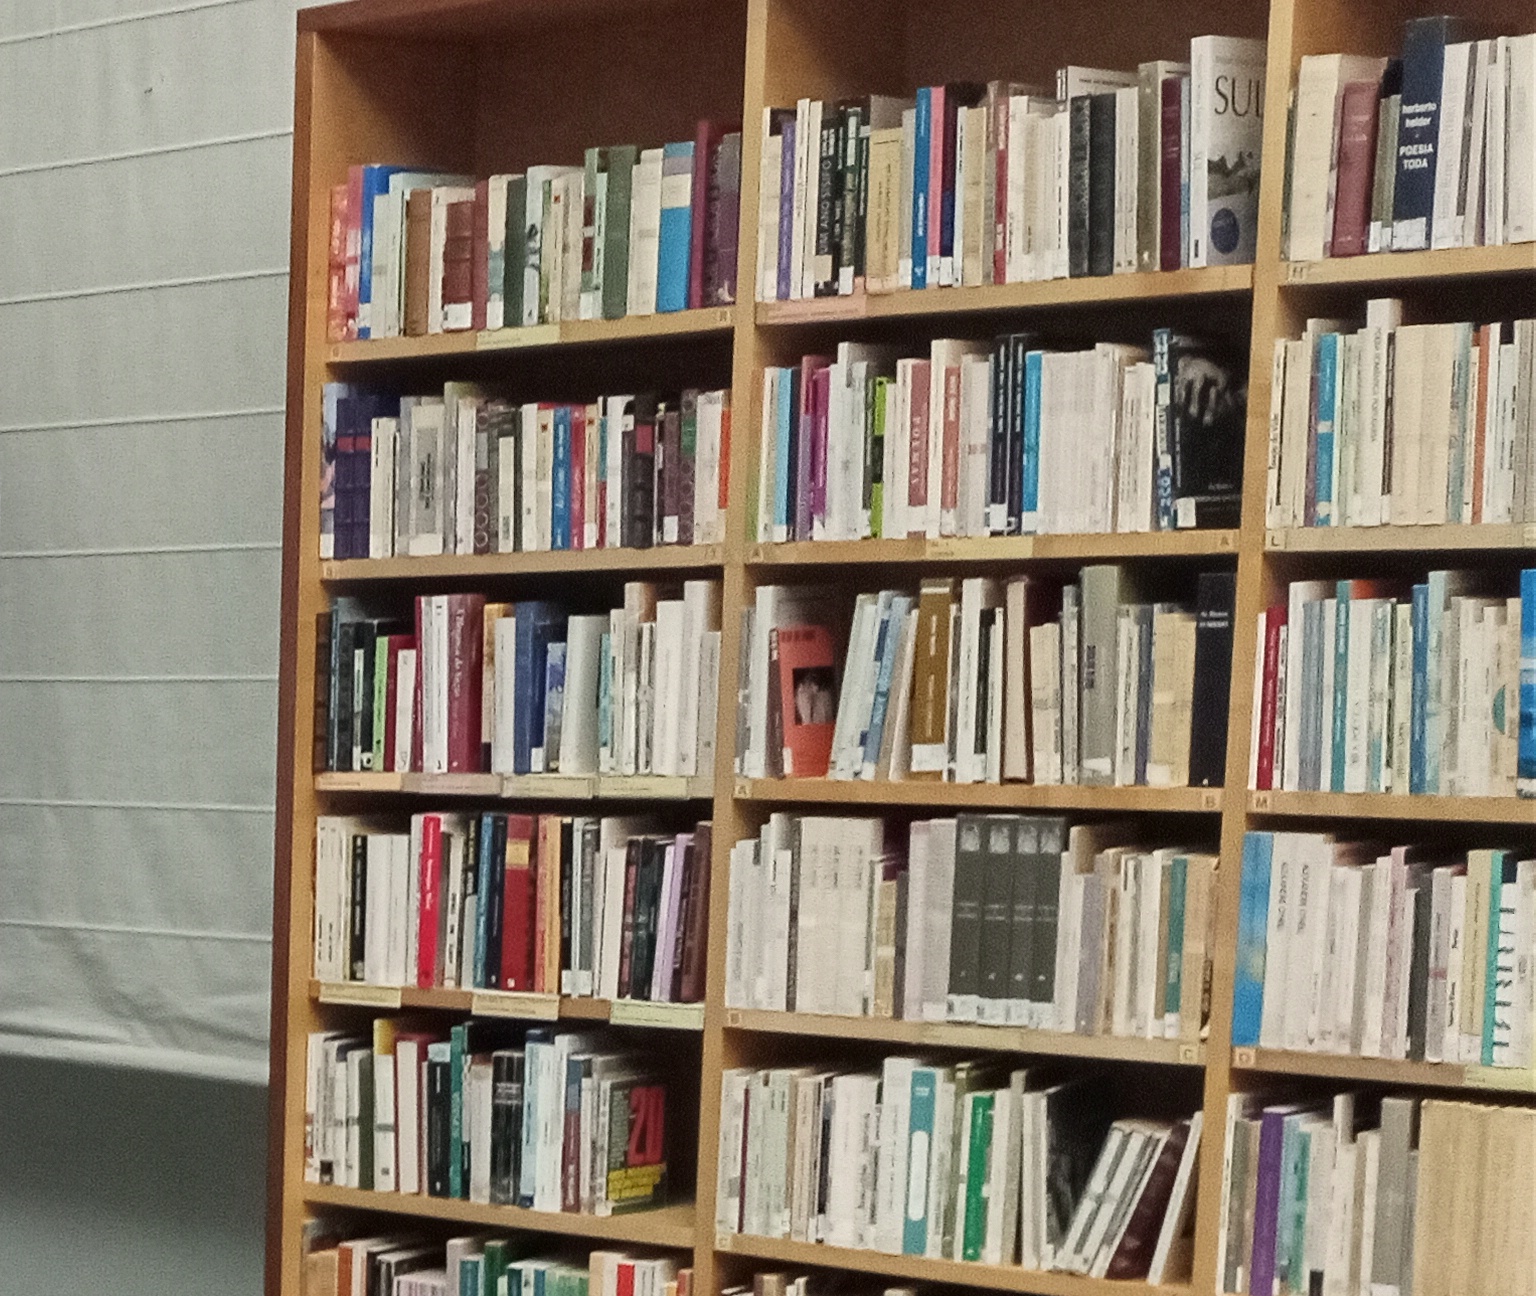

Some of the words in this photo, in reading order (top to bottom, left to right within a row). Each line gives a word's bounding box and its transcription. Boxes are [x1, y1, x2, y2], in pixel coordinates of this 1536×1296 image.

[1399, 143, 1434, 157] POESIA
[1403, 158, 1428, 171] TODA
[1270, 535, 1280, 547] L
